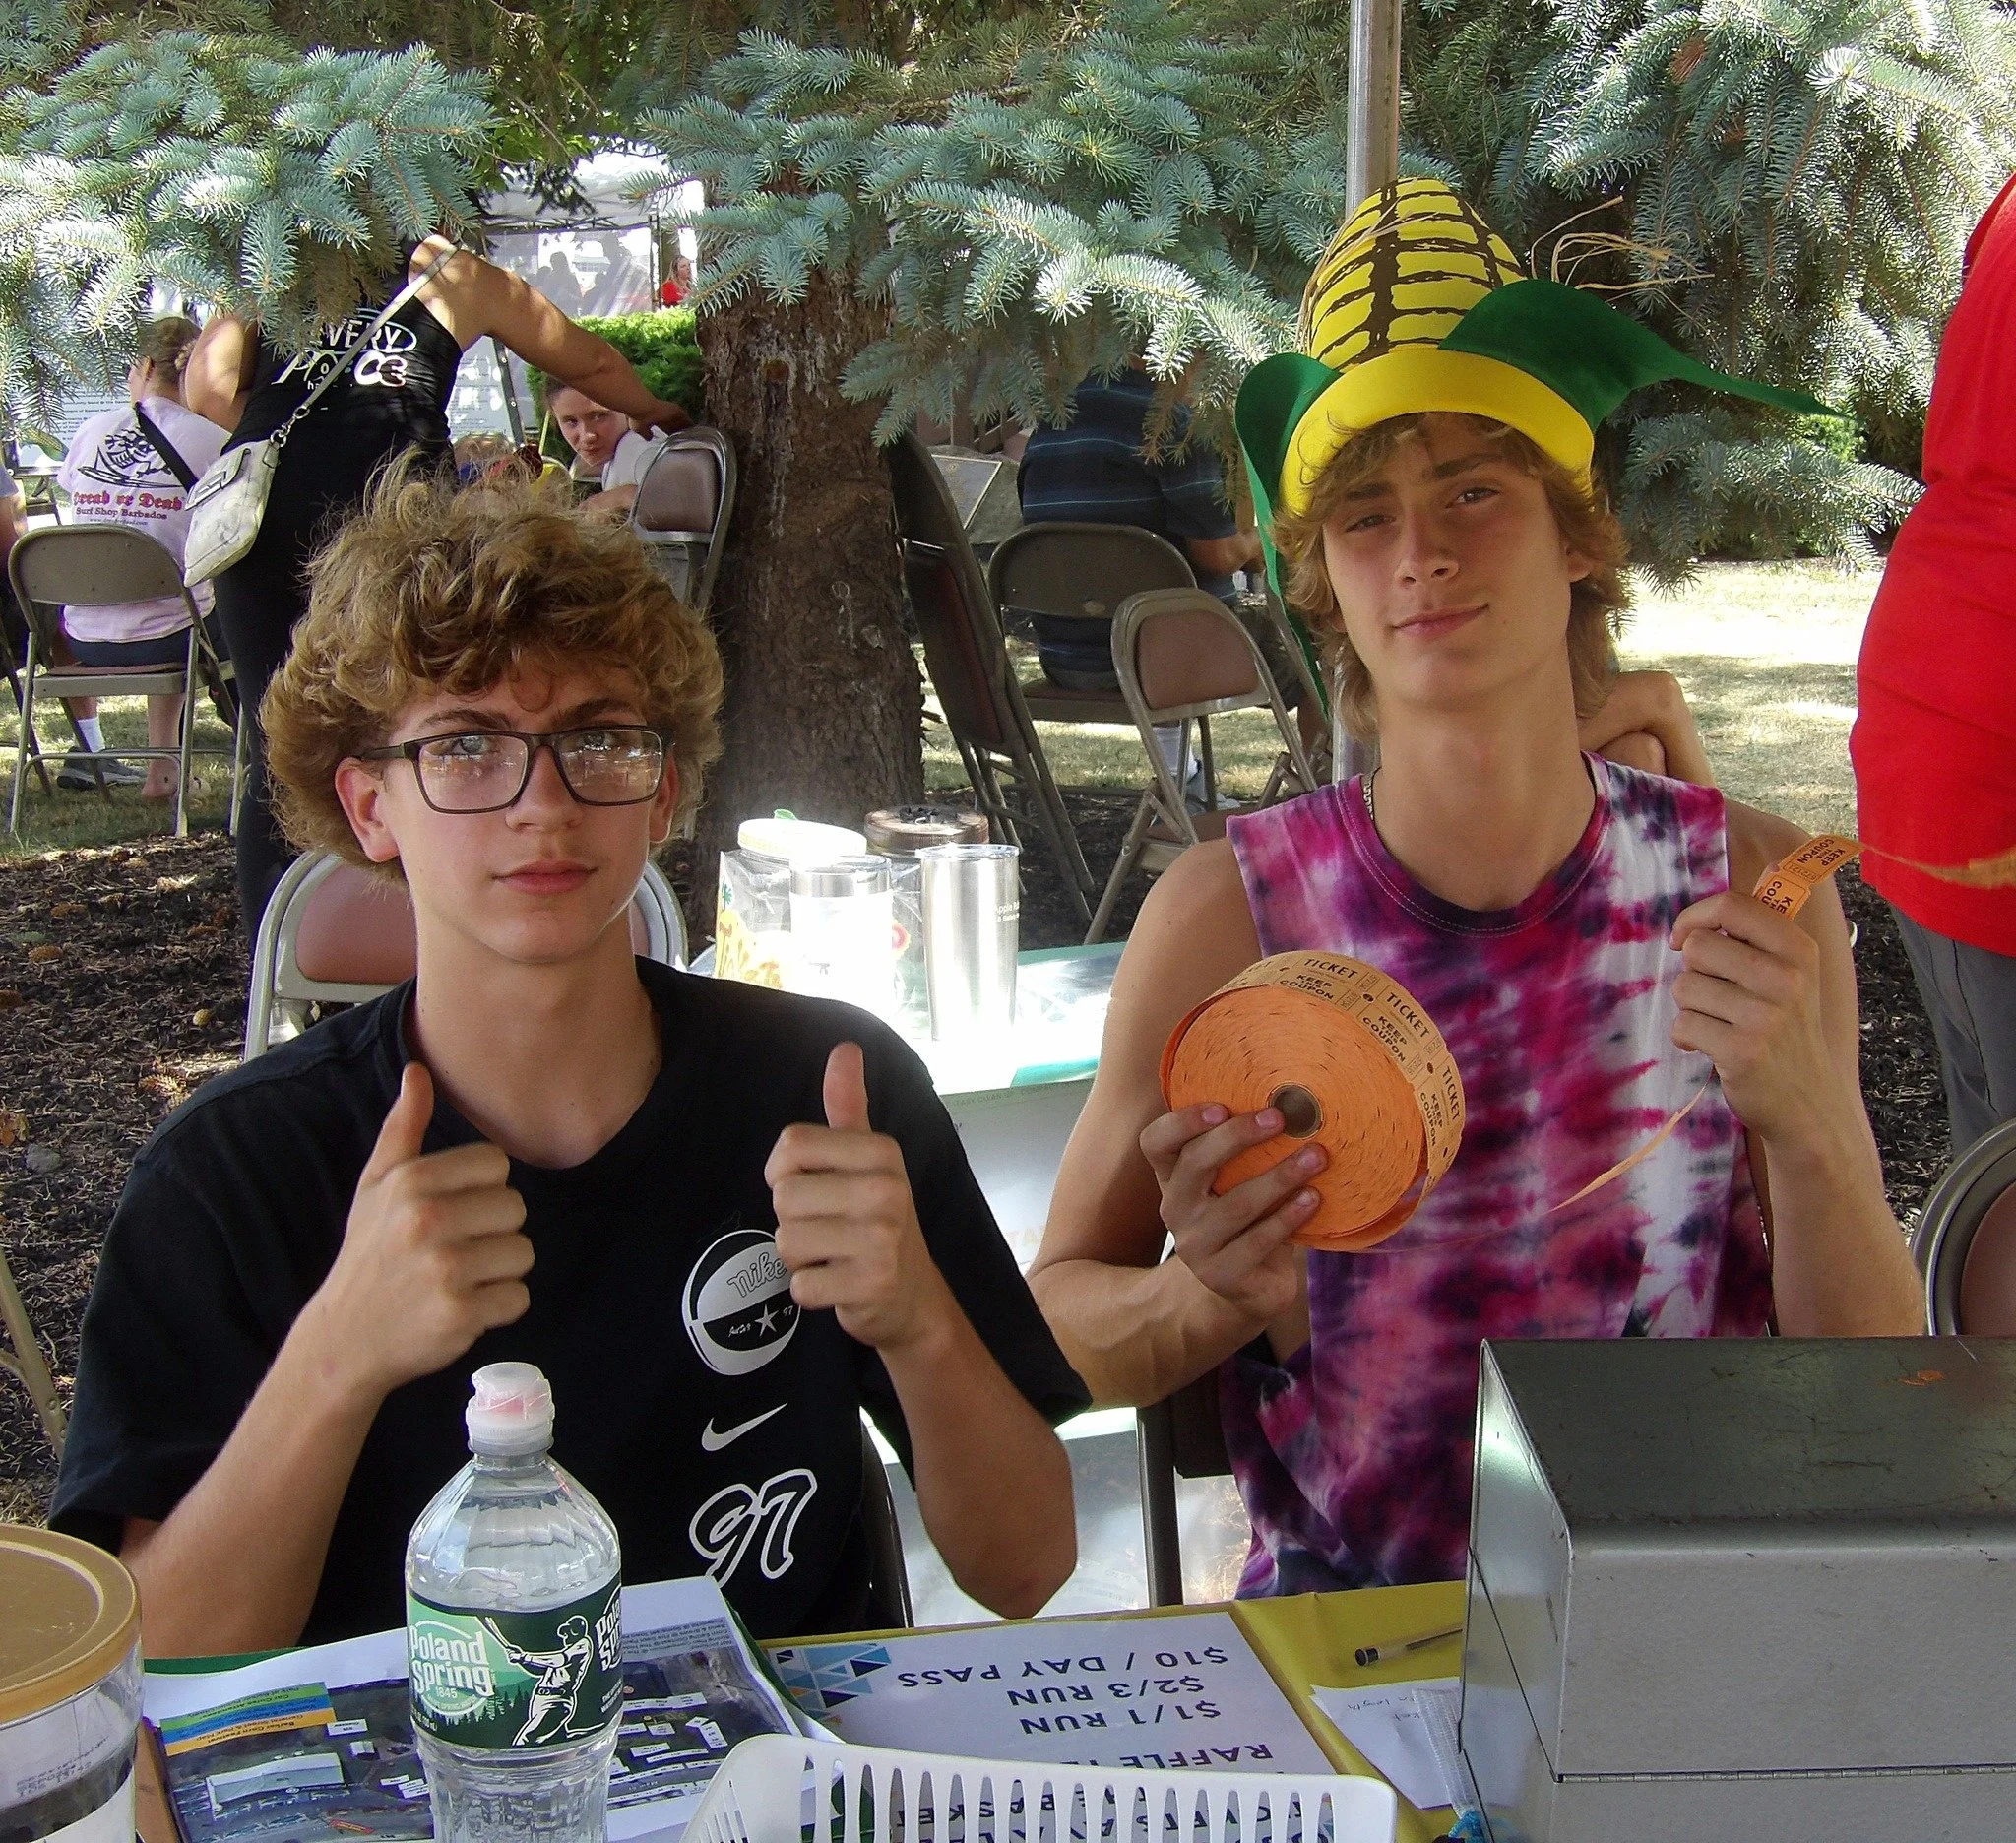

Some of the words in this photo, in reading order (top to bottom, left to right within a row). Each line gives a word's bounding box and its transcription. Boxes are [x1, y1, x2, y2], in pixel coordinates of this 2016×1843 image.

[310, 318, 401, 352] VERY
[95, 508, 118, 518] Shop
[121, 508, 167, 520] Barbados
[1797, 838, 1834, 864] COUPON
[1821, 848, 1846, 866] KEEP
[1761, 880, 1782, 905] COU
[1777, 896, 1793, 915] KE
[1296, 974, 1333, 987] KEEP
[1303, 958, 1358, 979] TICKET
[1280, 980, 1334, 1000] COUPON
[1386, 992, 1430, 1037] TICKET
[1362, 1017, 1406, 1062] COUPON
[1378, 1016, 1408, 1045] KEEP
[1442, 1066, 1460, 1120] TICKET
[1420, 1092, 1436, 1146] COUPON
[689, 1468, 818, 1588] 97
[595, 1599, 621, 1649] Pola
[410, 1625, 489, 1665] Poland
[599, 1621, 621, 1672] Spr
[1155, 1646, 1228, 1668] $10
[412, 1660, 495, 1697] Spring
[897, 1664, 1002, 1687] PASS
[1021, 1656, 1107, 1677] DAY
[436, 1686, 457, 1699] 1845
[1006, 1684, 1093, 1706] RUN
[1107, 1676, 1205, 1698] $2/3
[1019, 1712, 1108, 1735] RUN
[1128, 1699, 1222, 1725] $1/1
[1119, 1744, 1274, 1769] RAFFLE
